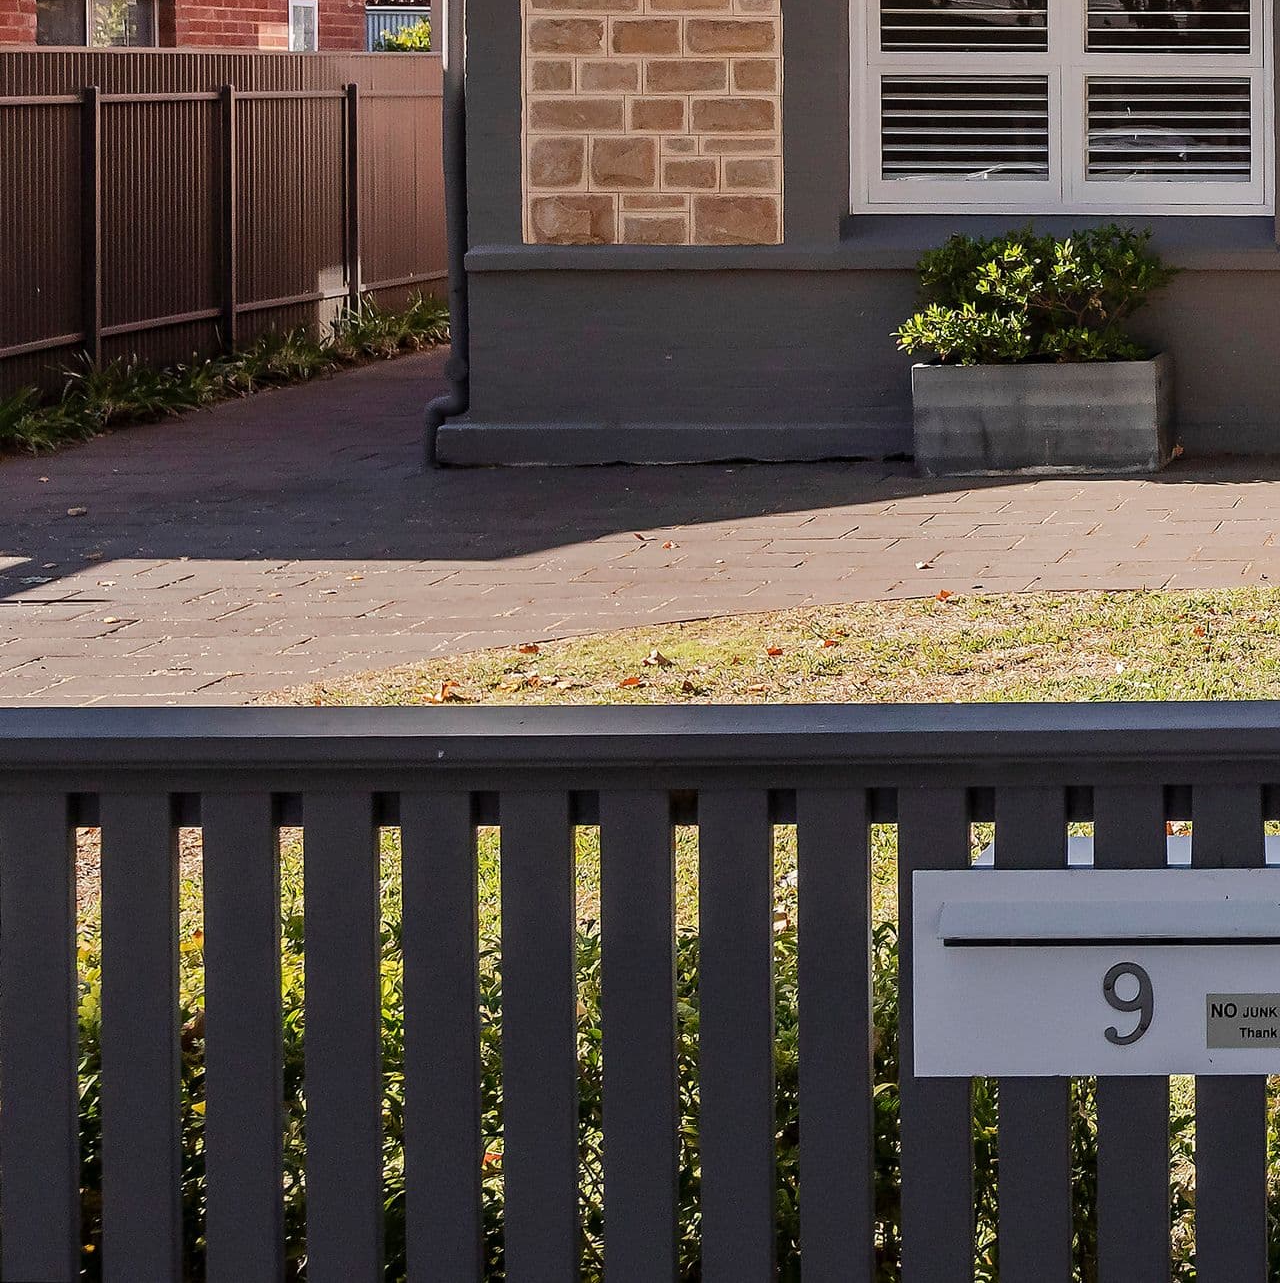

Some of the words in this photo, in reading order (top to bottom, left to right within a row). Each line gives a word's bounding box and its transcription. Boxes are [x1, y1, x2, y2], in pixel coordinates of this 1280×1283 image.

[1102, 961, 1155, 1046] 9
[1211, 1003, 1238, 1019] NO
[1242, 1007, 1278, 1018] JUNK
[1239, 1027, 1278, 1038] Thank
